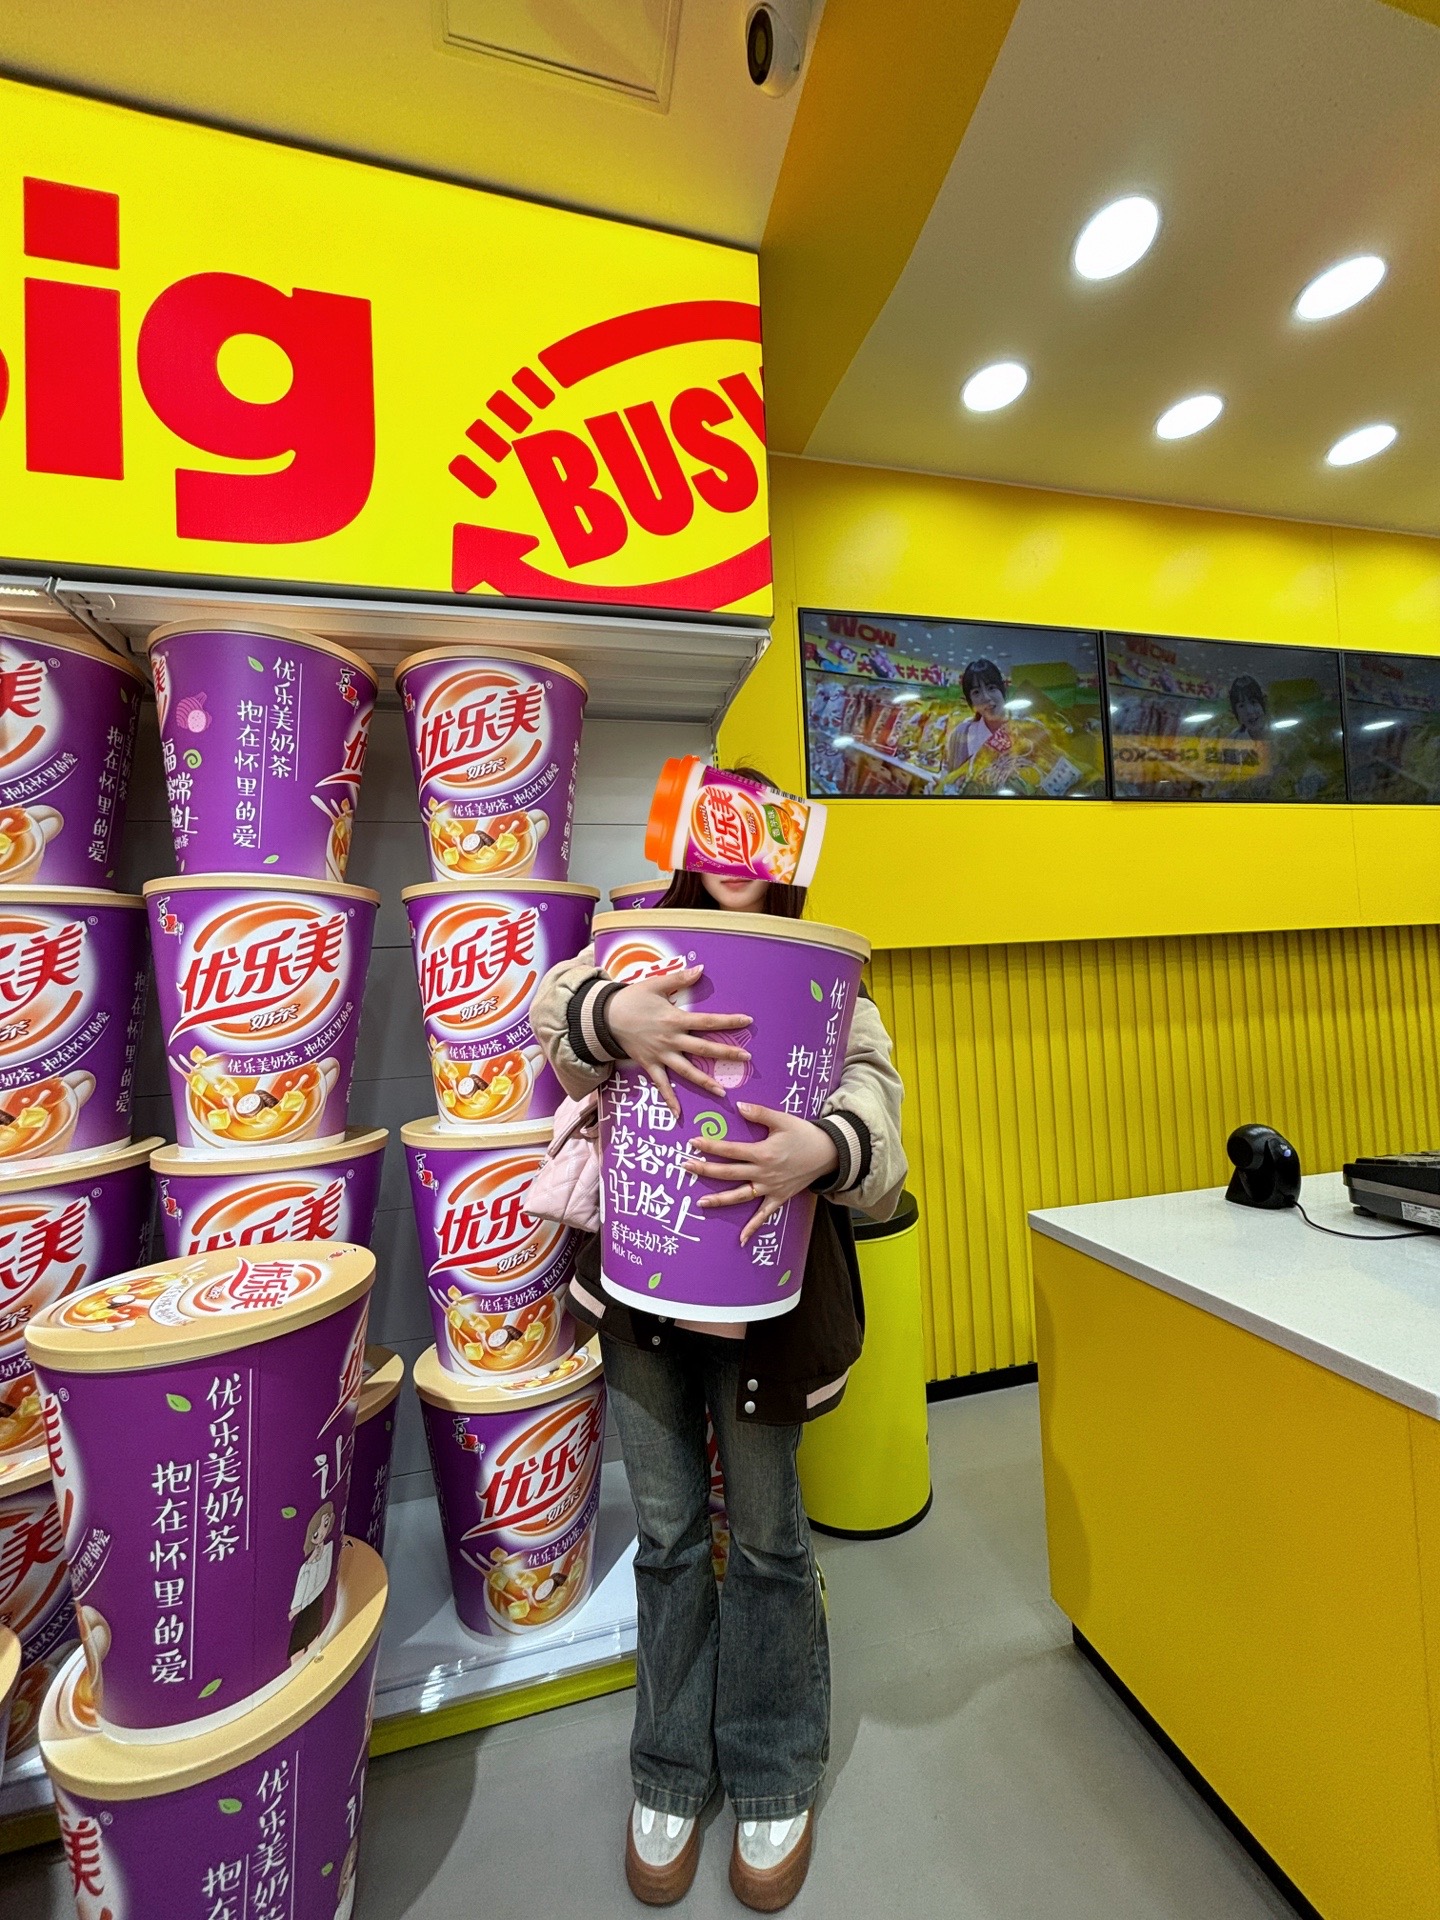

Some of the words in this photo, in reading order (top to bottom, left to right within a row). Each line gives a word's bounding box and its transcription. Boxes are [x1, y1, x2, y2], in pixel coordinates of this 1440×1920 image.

[0, 176, 376, 544] ig
[268, 656, 296, 779] 优乐美奶茶
[417, 685, 543, 773] 优乐美
[88, 725, 123, 863] 抱在怀里的爱
[233, 700, 263, 849] 抱在怀里的爱
[706, 786, 744, 863] 优乐美
[178, 912, 348, 1014] 优乐美
[419, 907, 538, 1007] 优乐美
[250, 1003, 301, 1031] 奶茶
[460, 996, 499, 1022] 奶茶
[811, 977, 846, 1117] 优乐美奶
[607, 1071, 676, 1131] 幸福
[610, 1125, 706, 1190] 笑容常
[436, 1180, 537, 1255] 优乐
[609, 1168, 705, 1241] 驻脸上
[611, 1221, 679, 1256] 香芋味奶茶
[496, 1243, 539, 1275] 奶茶
[612, 1241, 626, 1259] Milk
[627, 1249, 643, 1266] Tea
[202, 1373, 243, 1562] 优乐美奶茶
[150, 1461, 192, 1684] 抱在怀里的爱
